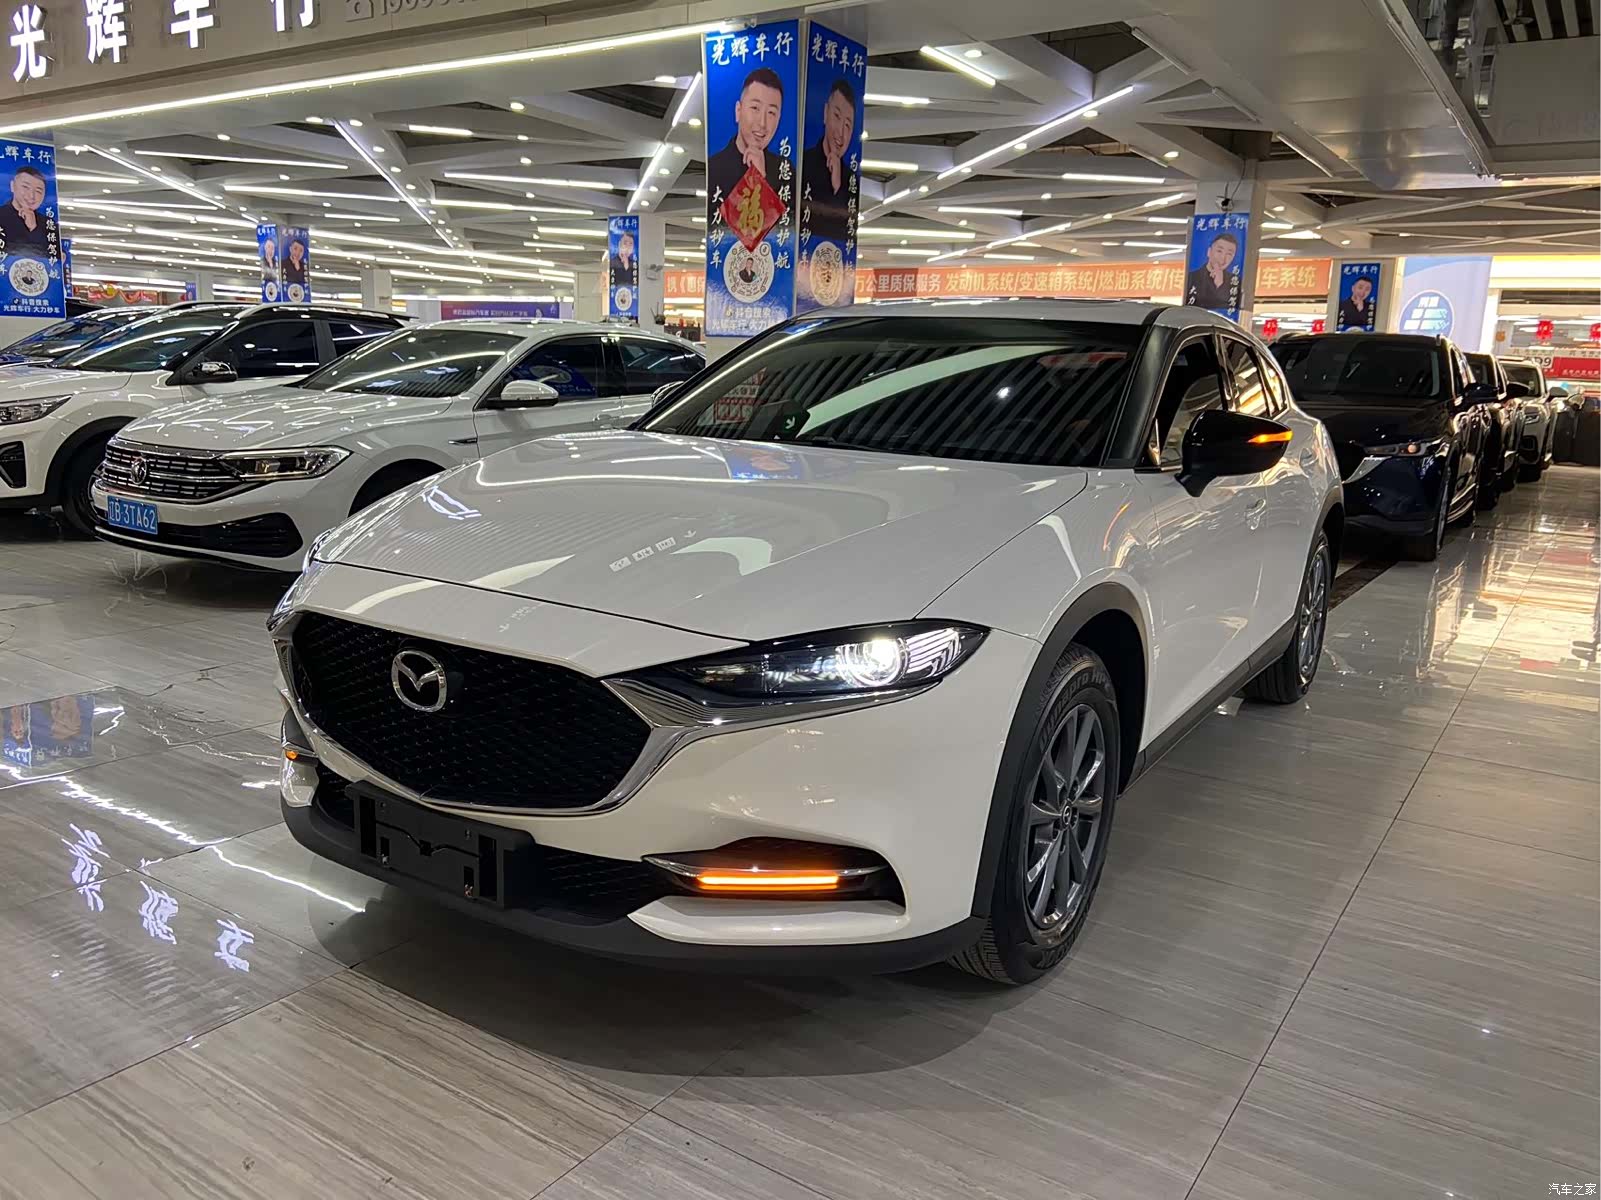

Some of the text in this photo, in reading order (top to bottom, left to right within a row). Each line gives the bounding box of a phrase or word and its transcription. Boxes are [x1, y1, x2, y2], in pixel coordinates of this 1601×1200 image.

[711, 31, 794, 66] 光辉车行
[812, 33, 864, 78] 光辉车行
[736, 183, 765, 238] 福
